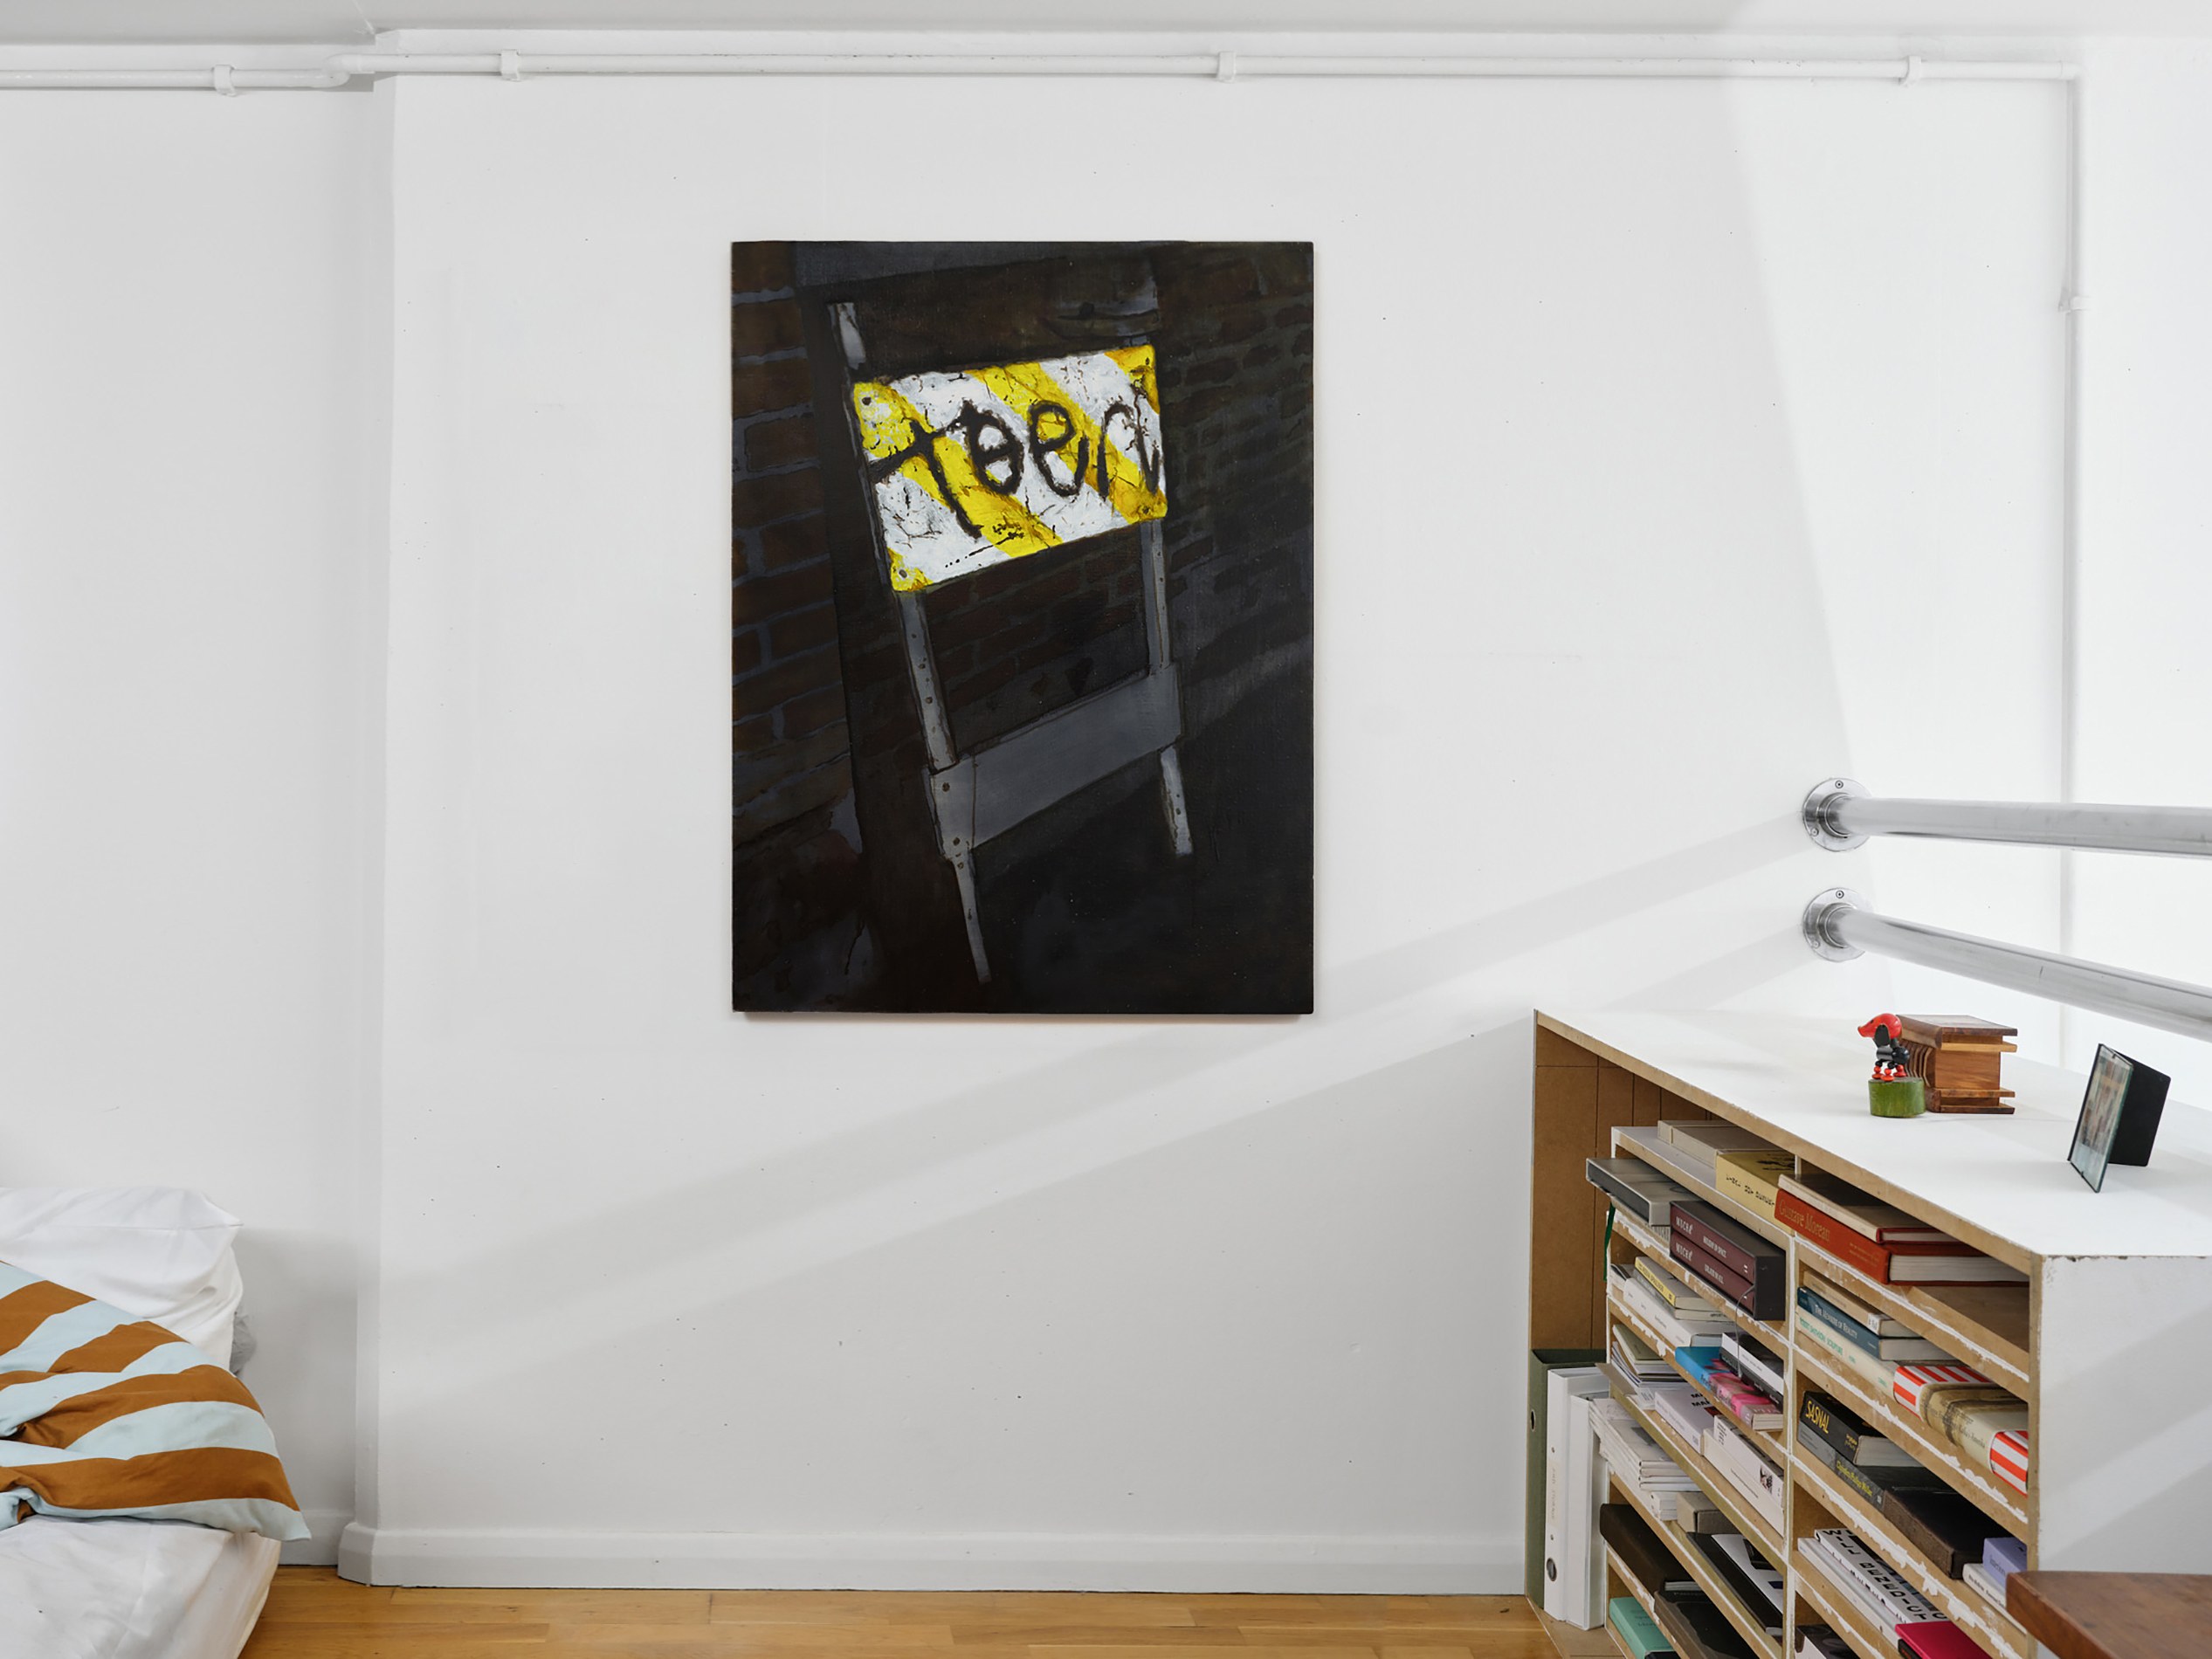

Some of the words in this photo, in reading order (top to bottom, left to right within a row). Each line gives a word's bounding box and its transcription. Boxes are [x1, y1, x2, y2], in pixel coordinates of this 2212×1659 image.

[1779, 1199, 1804, 1228] Gustave
[1805, 1213, 1830, 1242] Moreau
[1805, 1400, 1830, 1434] SASNAL
[1822, 1529, 1861, 1555] WILL
[1858, 1562, 1927, 1621] BENEDICT
